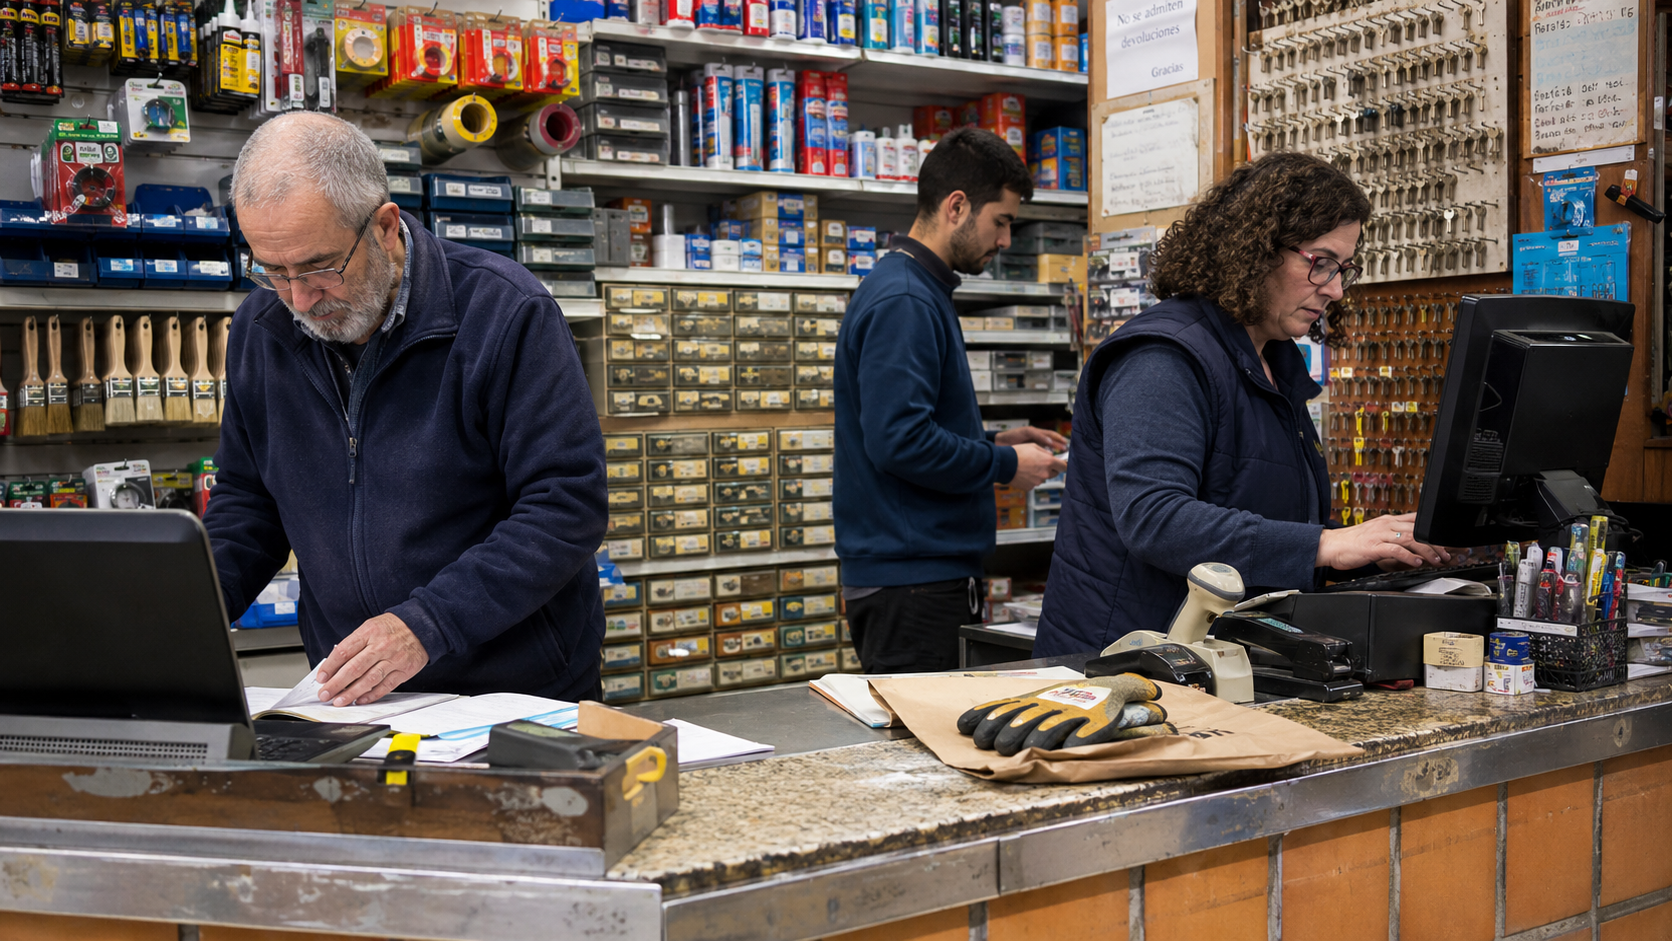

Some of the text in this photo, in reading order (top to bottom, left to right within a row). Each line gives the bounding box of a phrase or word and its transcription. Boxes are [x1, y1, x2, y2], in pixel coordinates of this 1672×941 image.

[1117, 0, 1183, 26] No se admiten
[1121, 25, 1180, 49] devoluciones
[1151, 63, 1184, 78] Gracias
